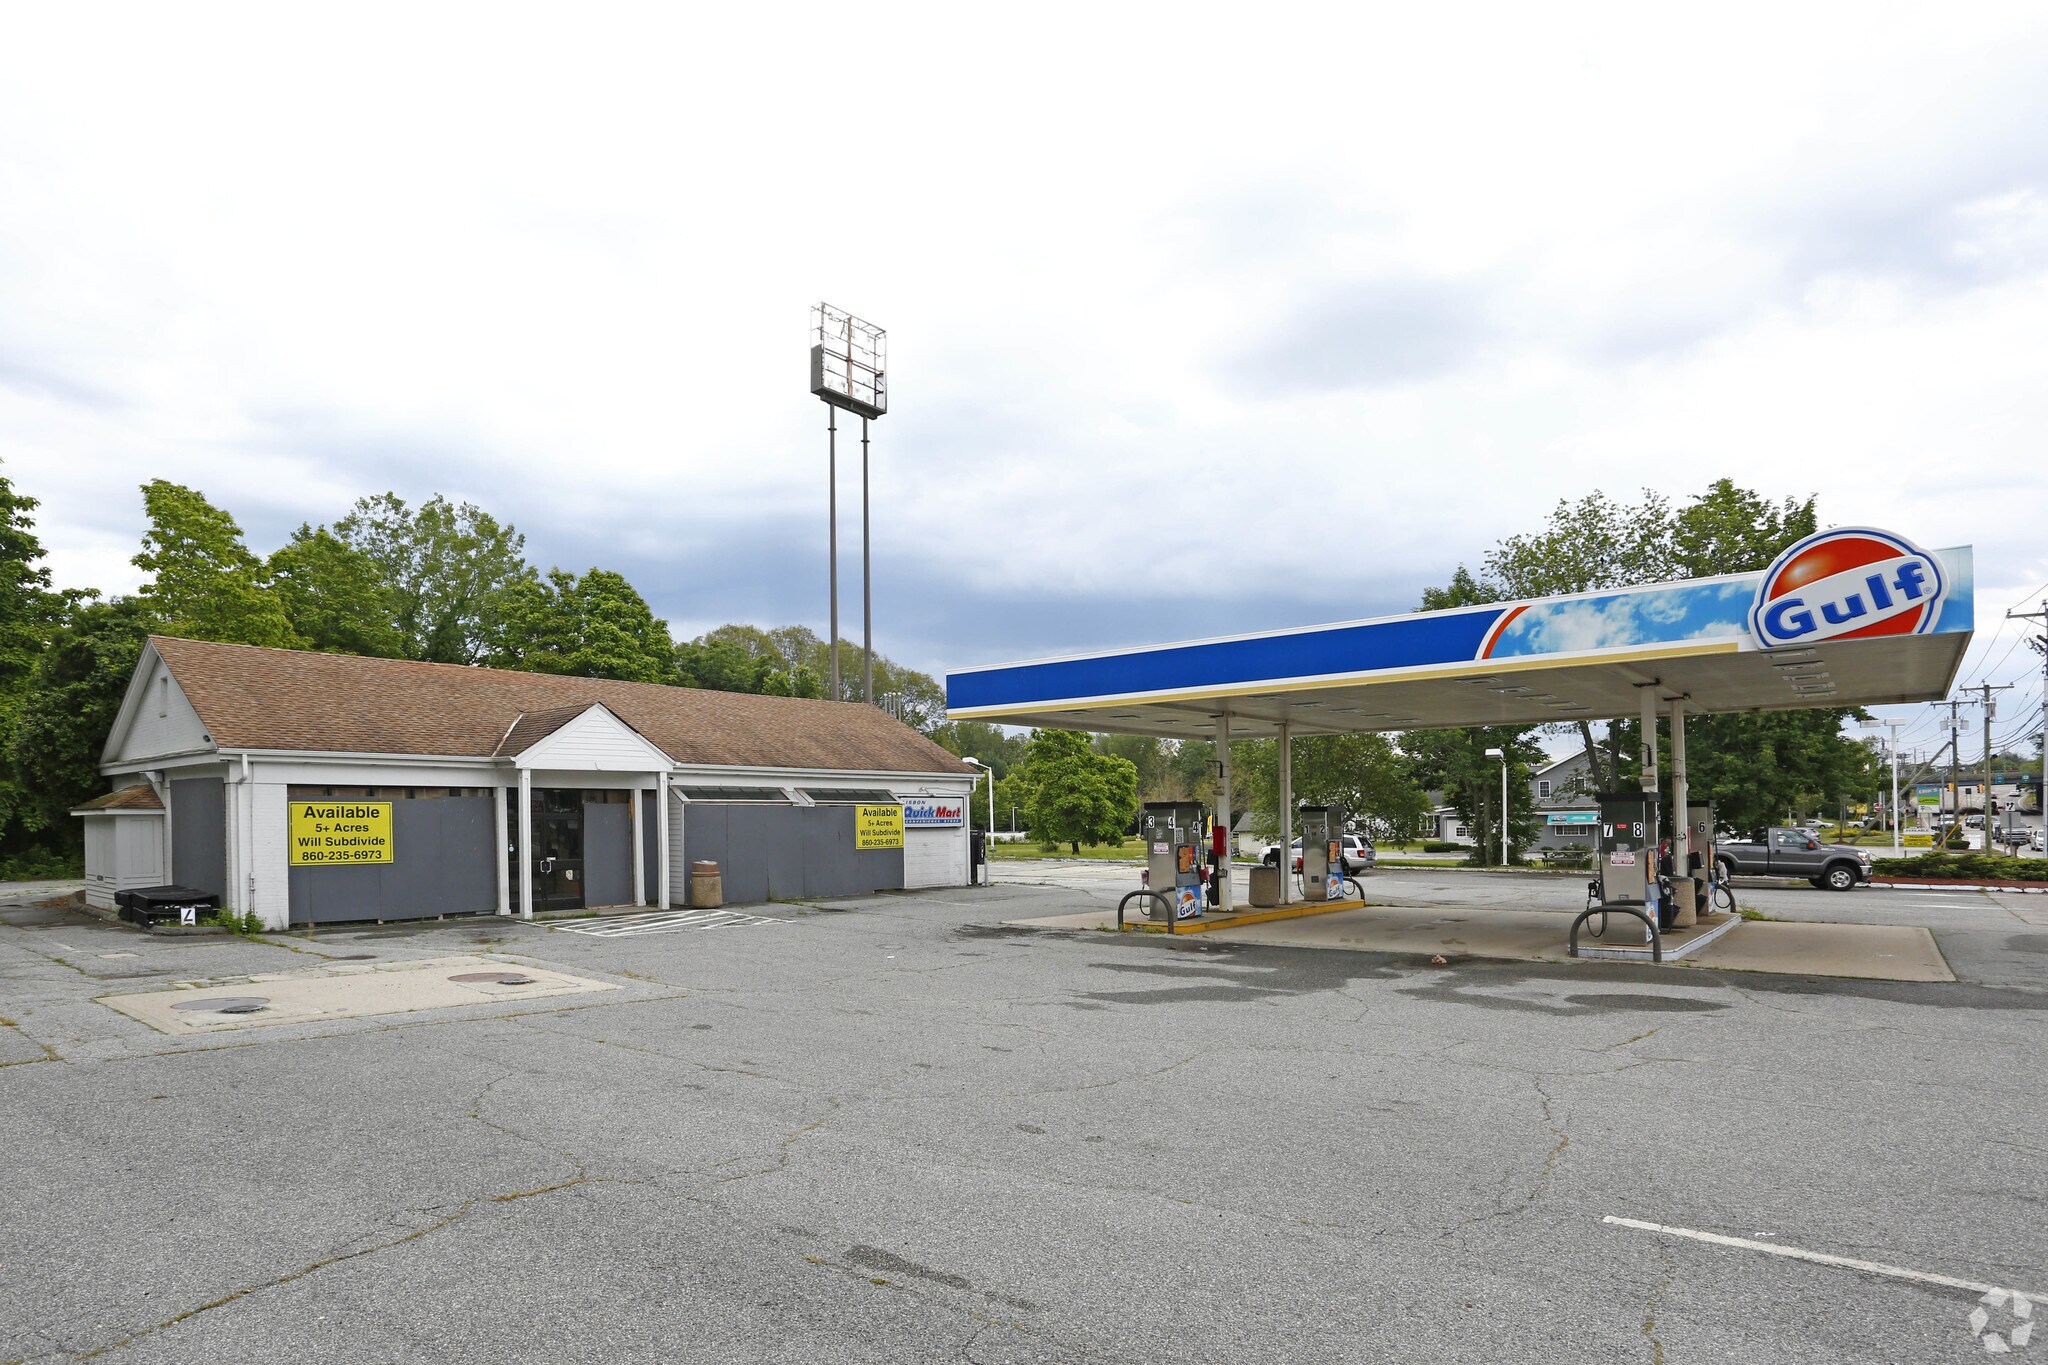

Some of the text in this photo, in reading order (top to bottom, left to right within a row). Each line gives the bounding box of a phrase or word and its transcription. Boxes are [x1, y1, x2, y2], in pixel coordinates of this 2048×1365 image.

[1764, 561, 1925, 640] Gulf
[303, 806, 380, 818] Available
[862, 807, 898, 817] Available
[904, 806, 961, 818] Quick Mart
[315, 823, 370, 832] 5+ Acres
[860, 828, 901, 837] Will Subdivide
[1604, 823, 1612, 836] 7
[1634, 823, 1642, 837] 8
[298, 837, 386, 847] Will Subdivide
[861, 838, 899, 846] 860-235-6973
[302, 850, 382, 861] 860-235-6973
[1180, 901, 1196, 916] Gulf
